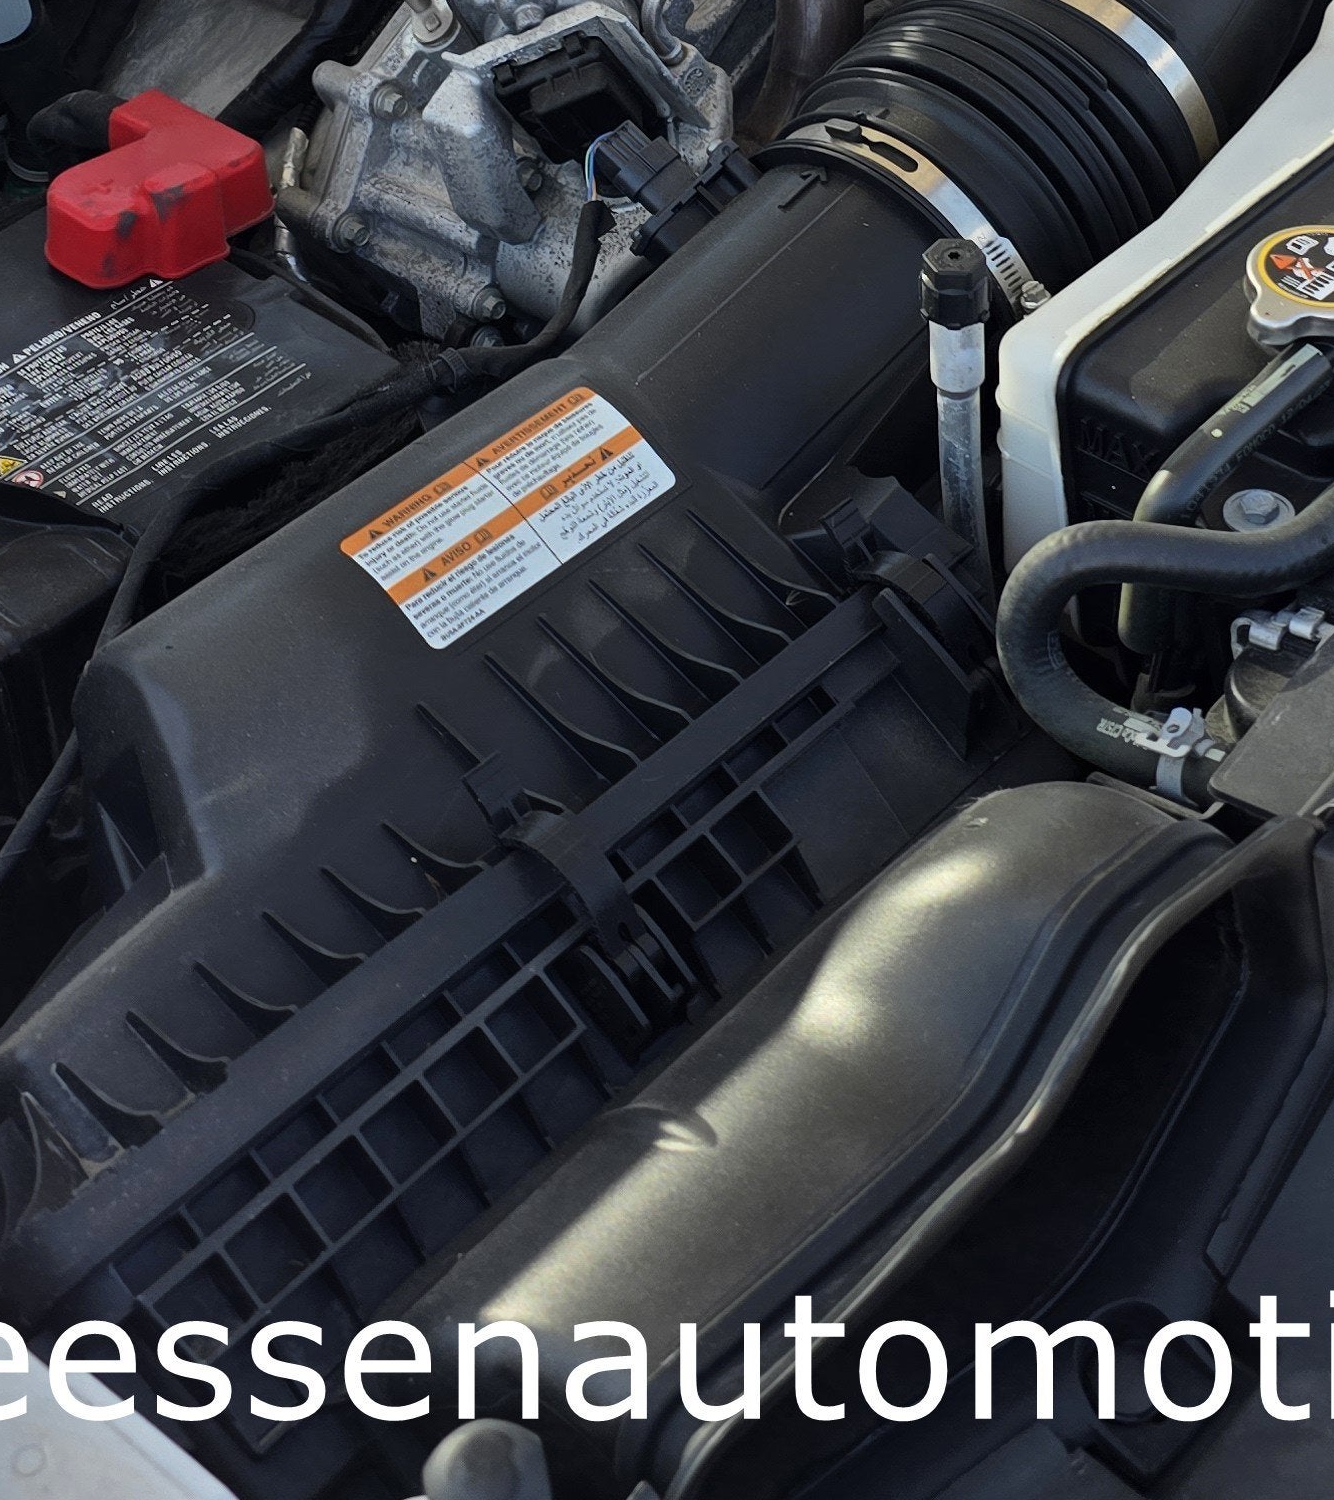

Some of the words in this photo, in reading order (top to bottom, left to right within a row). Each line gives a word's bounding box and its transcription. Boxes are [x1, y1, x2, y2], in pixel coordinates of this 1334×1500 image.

[490, 402, 568, 455] AVERTISSEMENT
[380, 491, 433, 528] WARNING
[438, 540, 473, 566] AVISO
